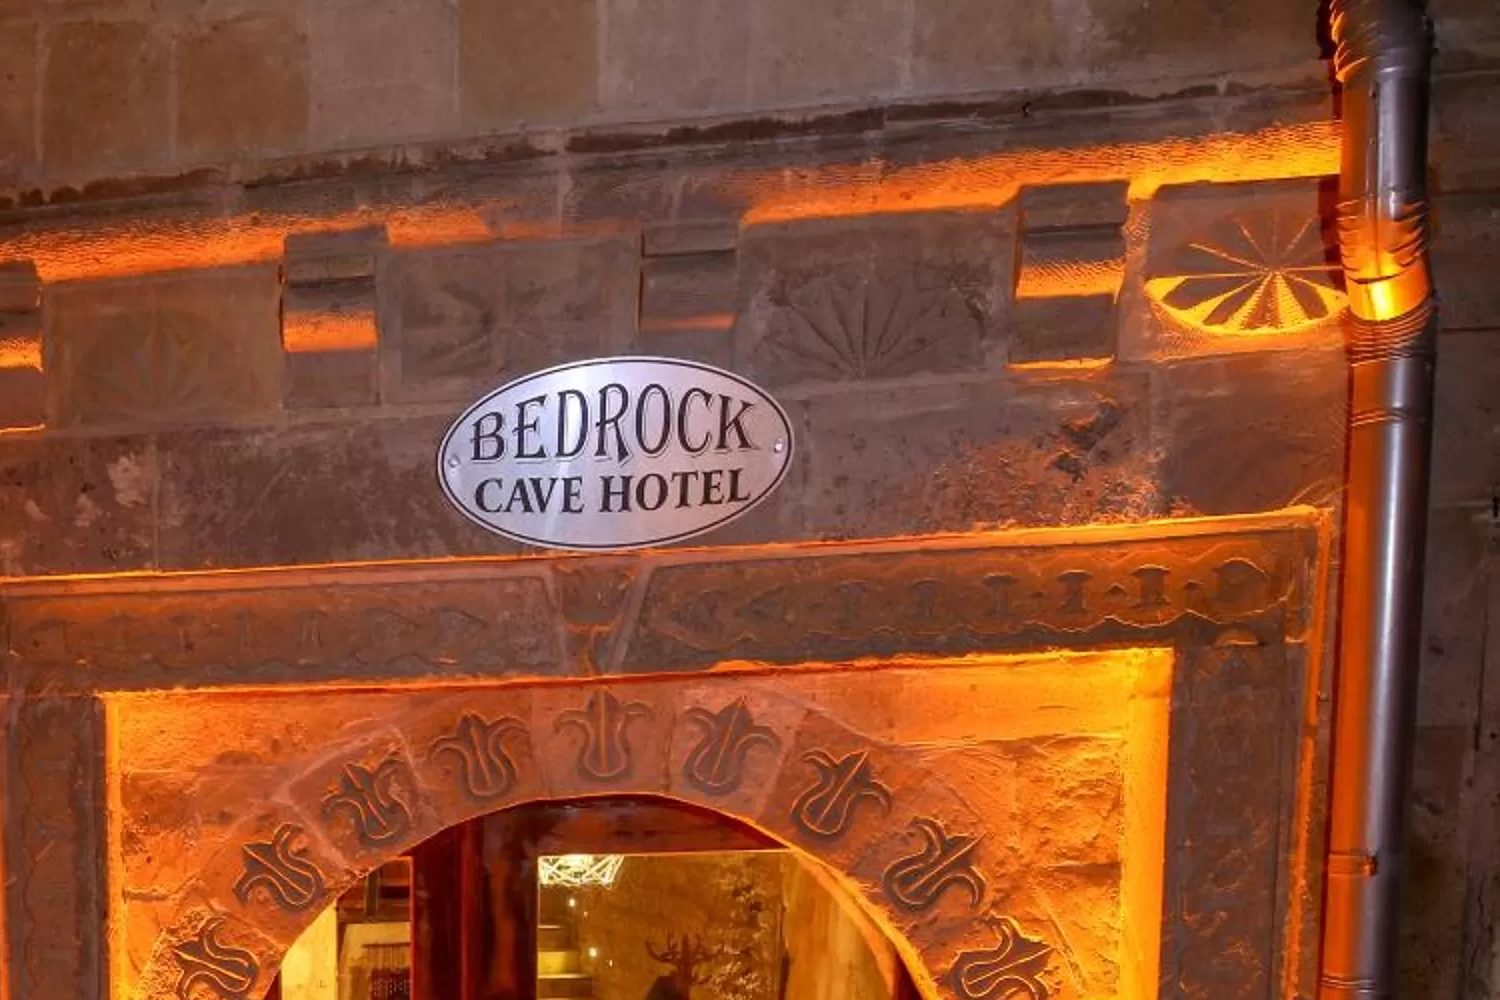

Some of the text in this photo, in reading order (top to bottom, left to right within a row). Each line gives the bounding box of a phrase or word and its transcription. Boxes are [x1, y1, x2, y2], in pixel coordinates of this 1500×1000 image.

[470, 383, 760, 464] BEDROCK
[475, 469, 751, 513] CAVE HOTEL
